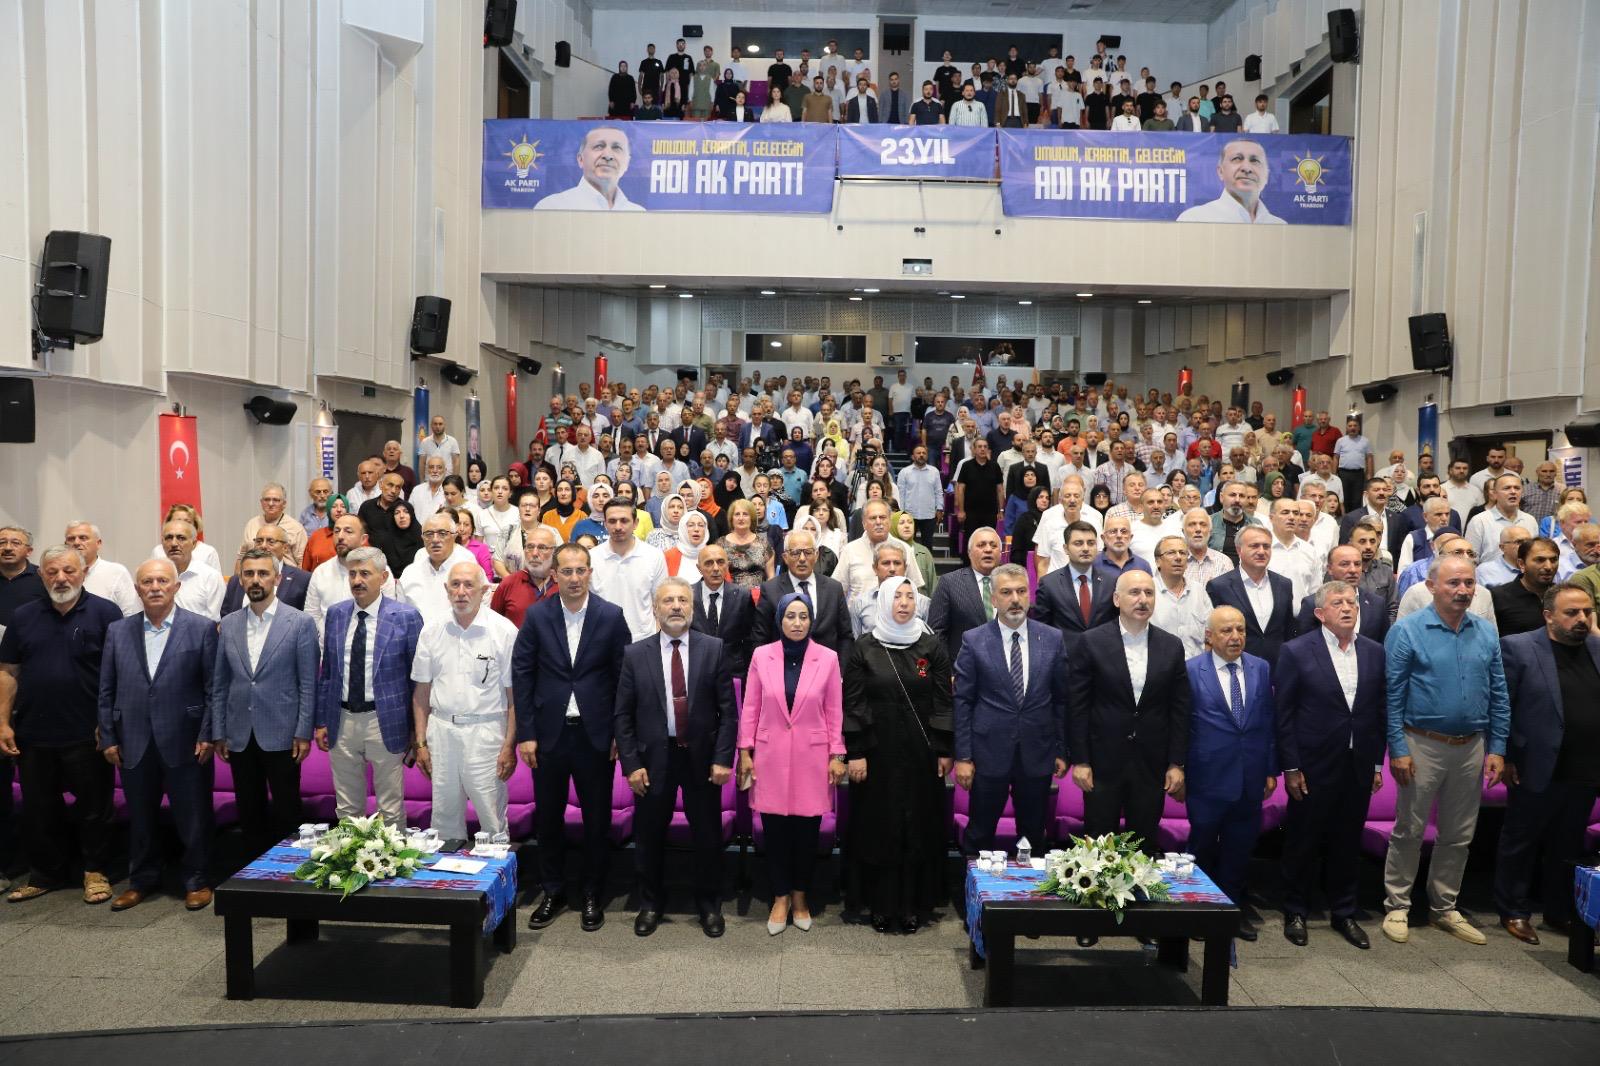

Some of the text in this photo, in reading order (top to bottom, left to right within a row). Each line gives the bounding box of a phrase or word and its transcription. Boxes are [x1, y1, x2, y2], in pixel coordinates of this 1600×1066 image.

[504, 179, 517, 187] AK
[650, 160, 804, 195] ADI AK PARTİ
[1034, 167, 1187, 204] ADI AK PARTİ
[1293, 194, 1306, 202] AK
